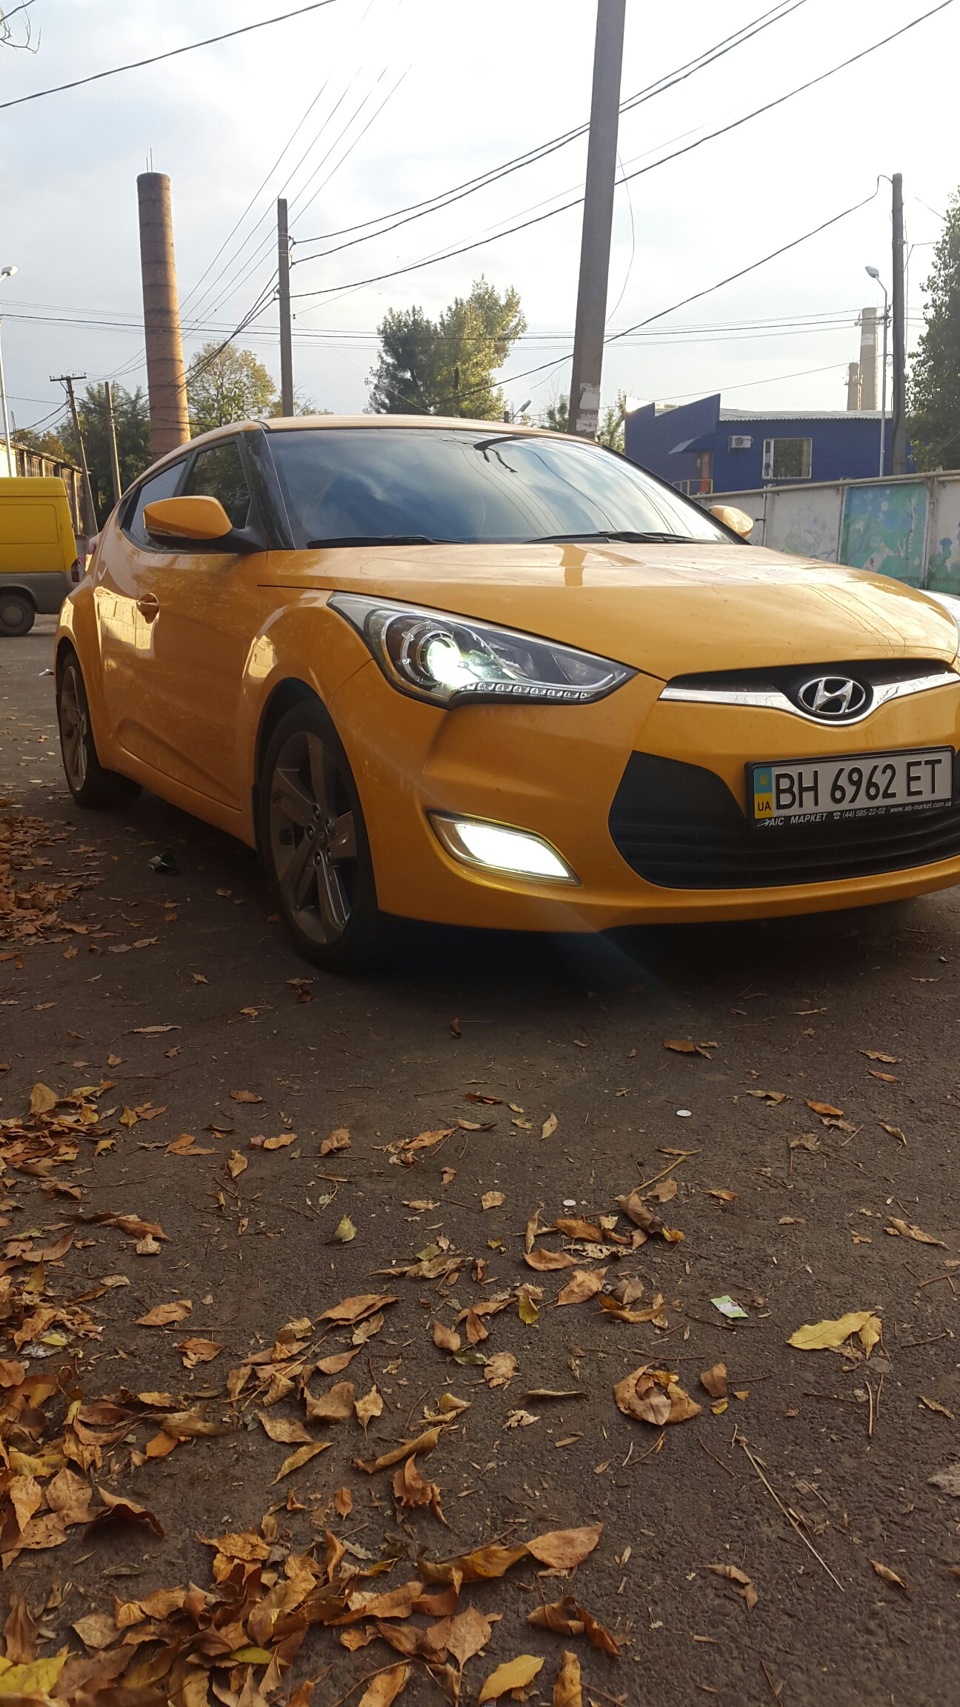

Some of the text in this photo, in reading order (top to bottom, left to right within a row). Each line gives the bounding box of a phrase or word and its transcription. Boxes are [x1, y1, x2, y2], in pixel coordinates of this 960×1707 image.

[775, 758, 942, 810] BH 6962 ET
[757, 801, 771, 812] UA
